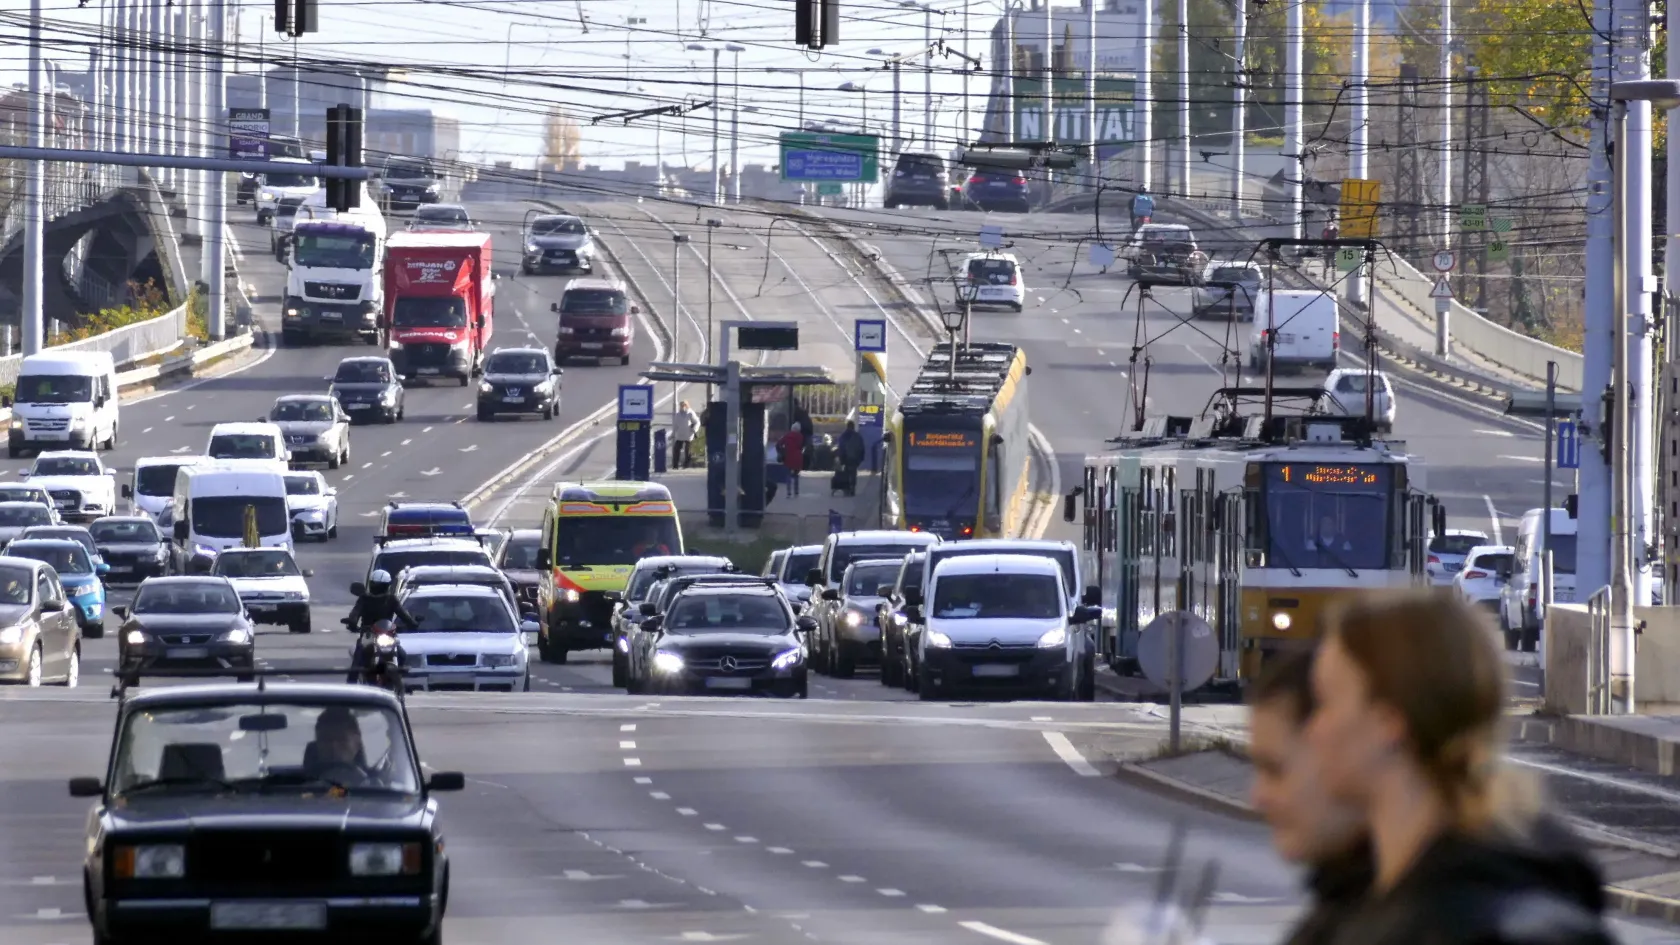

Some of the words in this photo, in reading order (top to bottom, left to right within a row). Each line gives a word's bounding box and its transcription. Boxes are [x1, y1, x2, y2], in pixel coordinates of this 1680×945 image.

[1491, 242, 1503, 252] 30
[1342, 250, 1354, 260] 15
[1439, 254, 1449, 265] 70
[909, 432, 915, 446] 1
[1281, 466, 1290, 482] 1
